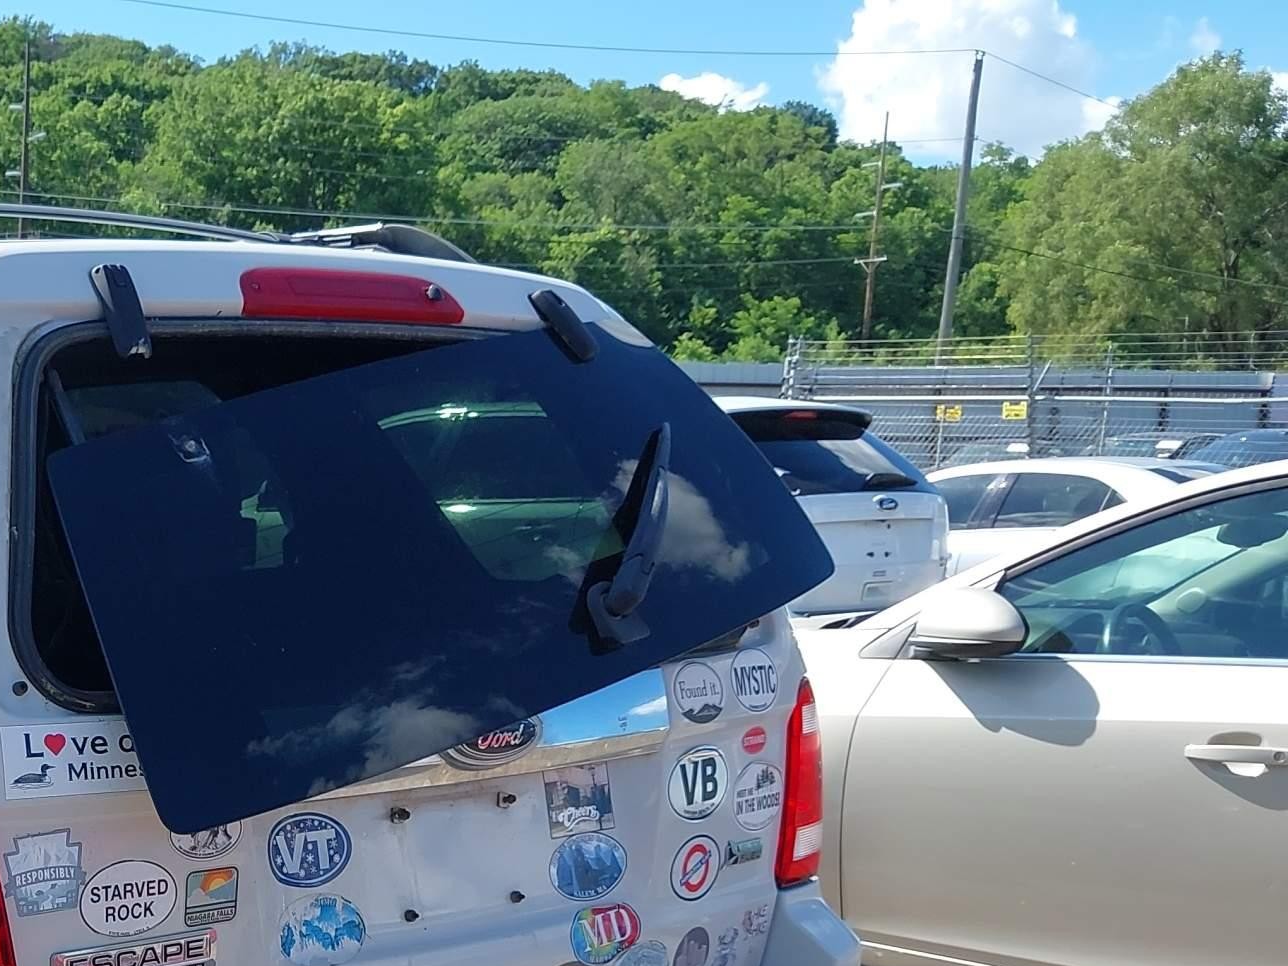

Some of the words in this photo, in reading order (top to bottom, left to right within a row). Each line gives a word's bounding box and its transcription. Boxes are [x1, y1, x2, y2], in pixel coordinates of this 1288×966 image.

[678, 680, 707, 699] Found
[709, 681, 719, 696] it.
[734, 665, 776, 696] MYSTIC
[478, 724, 524, 749] Ford
[680, 756, 719, 806] VB
[558, 805, 600, 830] Cheers
[736, 800, 744, 815] IN
[744, 797, 755, 813] THE
[275, 828, 336, 873] VT
[15, 866, 75, 887] RESPONSIBLY
[90, 879, 169, 903] STARVED
[105, 900, 154, 923] ROCK
[187, 911, 215, 922] NIAGARA
[216, 908, 234, 918] FALLS
[578, 908, 631, 952] MD
